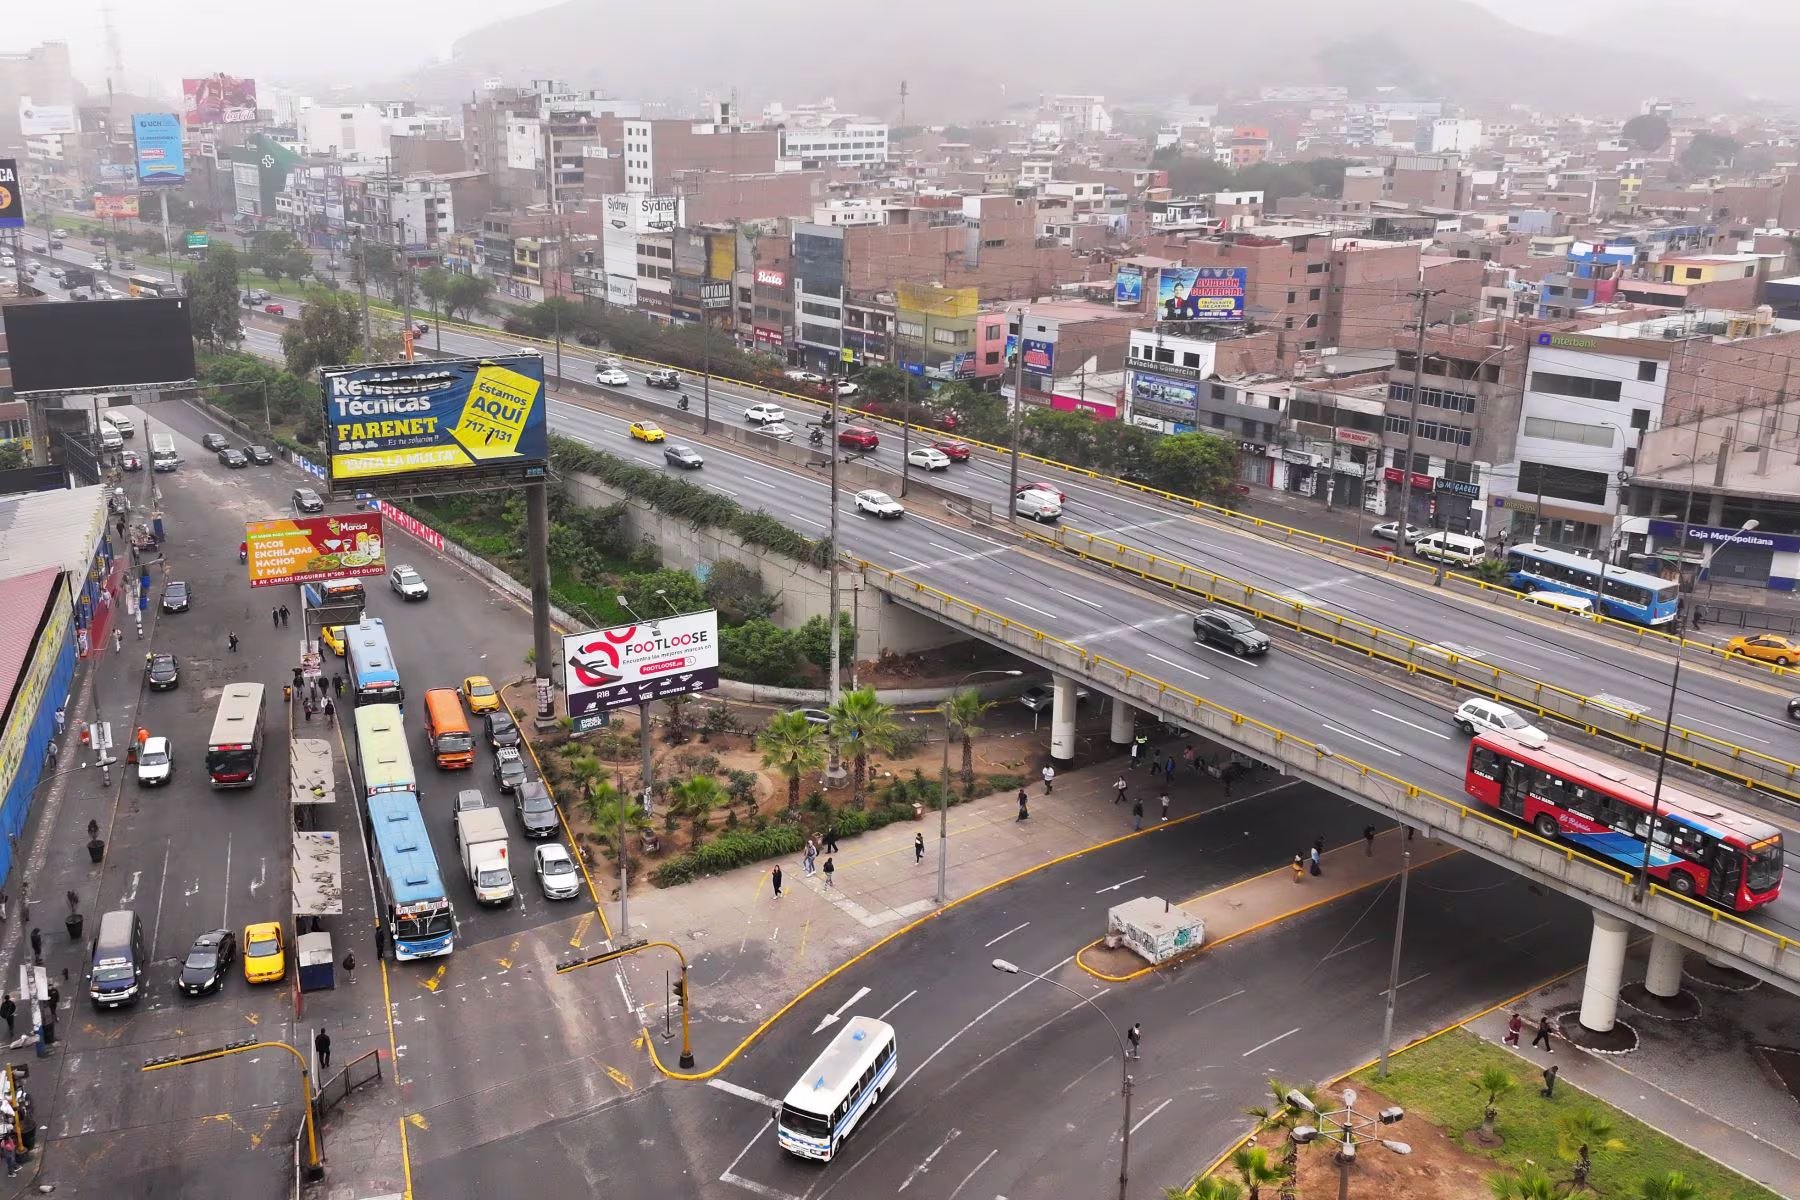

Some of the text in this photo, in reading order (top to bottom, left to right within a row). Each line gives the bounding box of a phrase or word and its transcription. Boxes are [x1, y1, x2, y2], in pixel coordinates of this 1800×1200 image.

[608, 196, 629, 215] Sydney
[641, 200, 677, 215] Sydney
[758, 271, 783, 286] Bata
[1196, 276, 1240, 287] AVIACIÓN
[701, 283, 730, 298] NOTARIA
[1191, 287, 1244, 297] COMERCIAL
[1552, 335, 1597, 349] Interbank
[1128, 359, 1196, 376] Aviación Comercial
[479, 382, 527, 406] Estamos
[335, 395, 431, 416] Técnicas
[472, 396, 527, 424] AQUÍ
[337, 416, 438, 441] FARENET
[340, 522, 367, 532] Marcial
[381, 501, 444, 551] PRESIDENTE
[254, 540, 284, 549] TACOS
[1689, 529, 1774, 546] Caja Metropolitana
[255, 547, 313, 559] ENCHILADAS
[256, 557, 295, 567] NACHOS
[270, 576, 294, 584] CARLOS
[294, 573, 326, 581] IZAGUIRRE
[362, 567, 383, 575] OLIVOS
[626, 631, 708, 656] FOOTLOOSE
[661, 650, 683, 658] mejores
[684, 646, 703, 654] marcas
[597, 690, 610, 699] R18
[660, 686, 686, 696] CONVERSE
